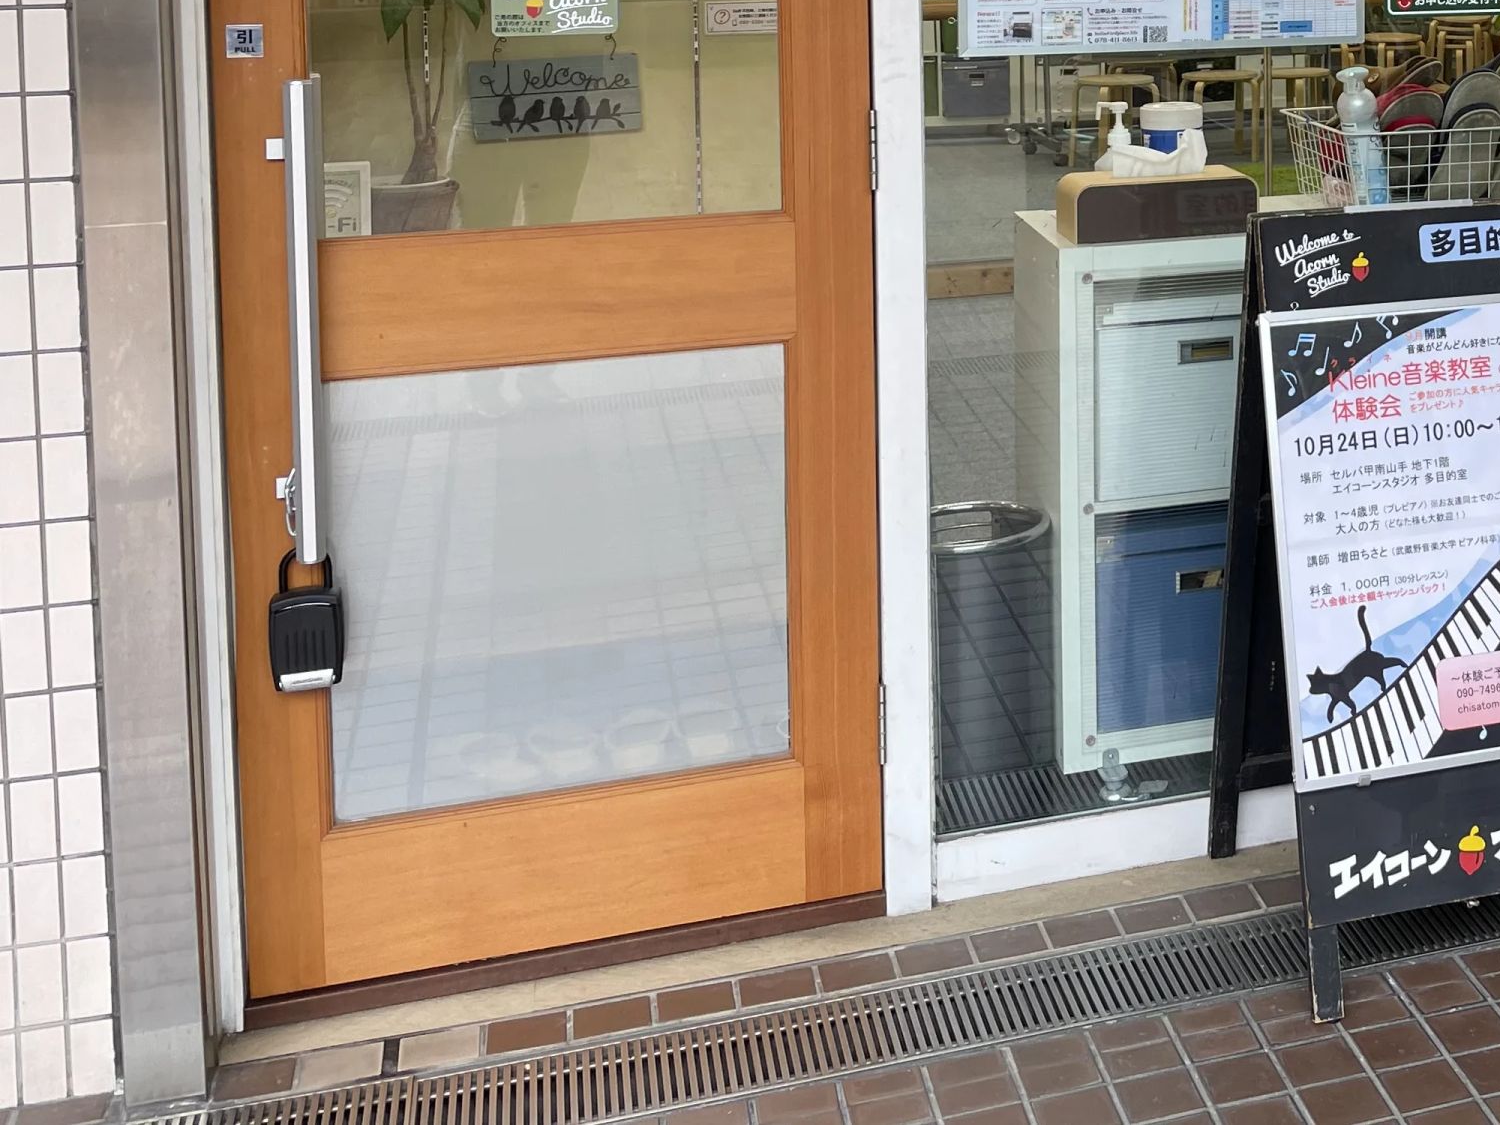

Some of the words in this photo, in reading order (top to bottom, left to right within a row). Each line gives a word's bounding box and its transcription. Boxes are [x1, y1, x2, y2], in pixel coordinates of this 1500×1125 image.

[557, 10, 613, 29] Studio
[234, 46, 257, 54] PULL
[236, 29, 254, 45] 引
[480, 62, 631, 98] Welcome
[1275, 233, 1340, 264] Welcome
[1342, 228, 1355, 240] to
[1294, 253, 1340, 278] Acorn
[1306, 266, 1351, 295] Studio
[1328, 355, 1493, 393] Kleine音楽教室
[1331, 393, 1403, 424] 体験会
[1299, 470, 1323, 485] 場所
[1330, 460, 1409, 481] セルバ甲南山手
[1411, 456, 1451, 472] 地下1階
[1332, 475, 1421, 495] エイコーンスタジオ
[1424, 467, 1469, 485] 多目的室
[1303, 511, 1327, 525] 対象
[1336, 518, 1380, 536] 大人の方
[1306, 554, 1331, 568] 講師
[1337, 546, 1389, 564] 増田ちさと
[1309, 583, 1333, 597] 料金
[1329, 839, 1452, 900] エイコーン
